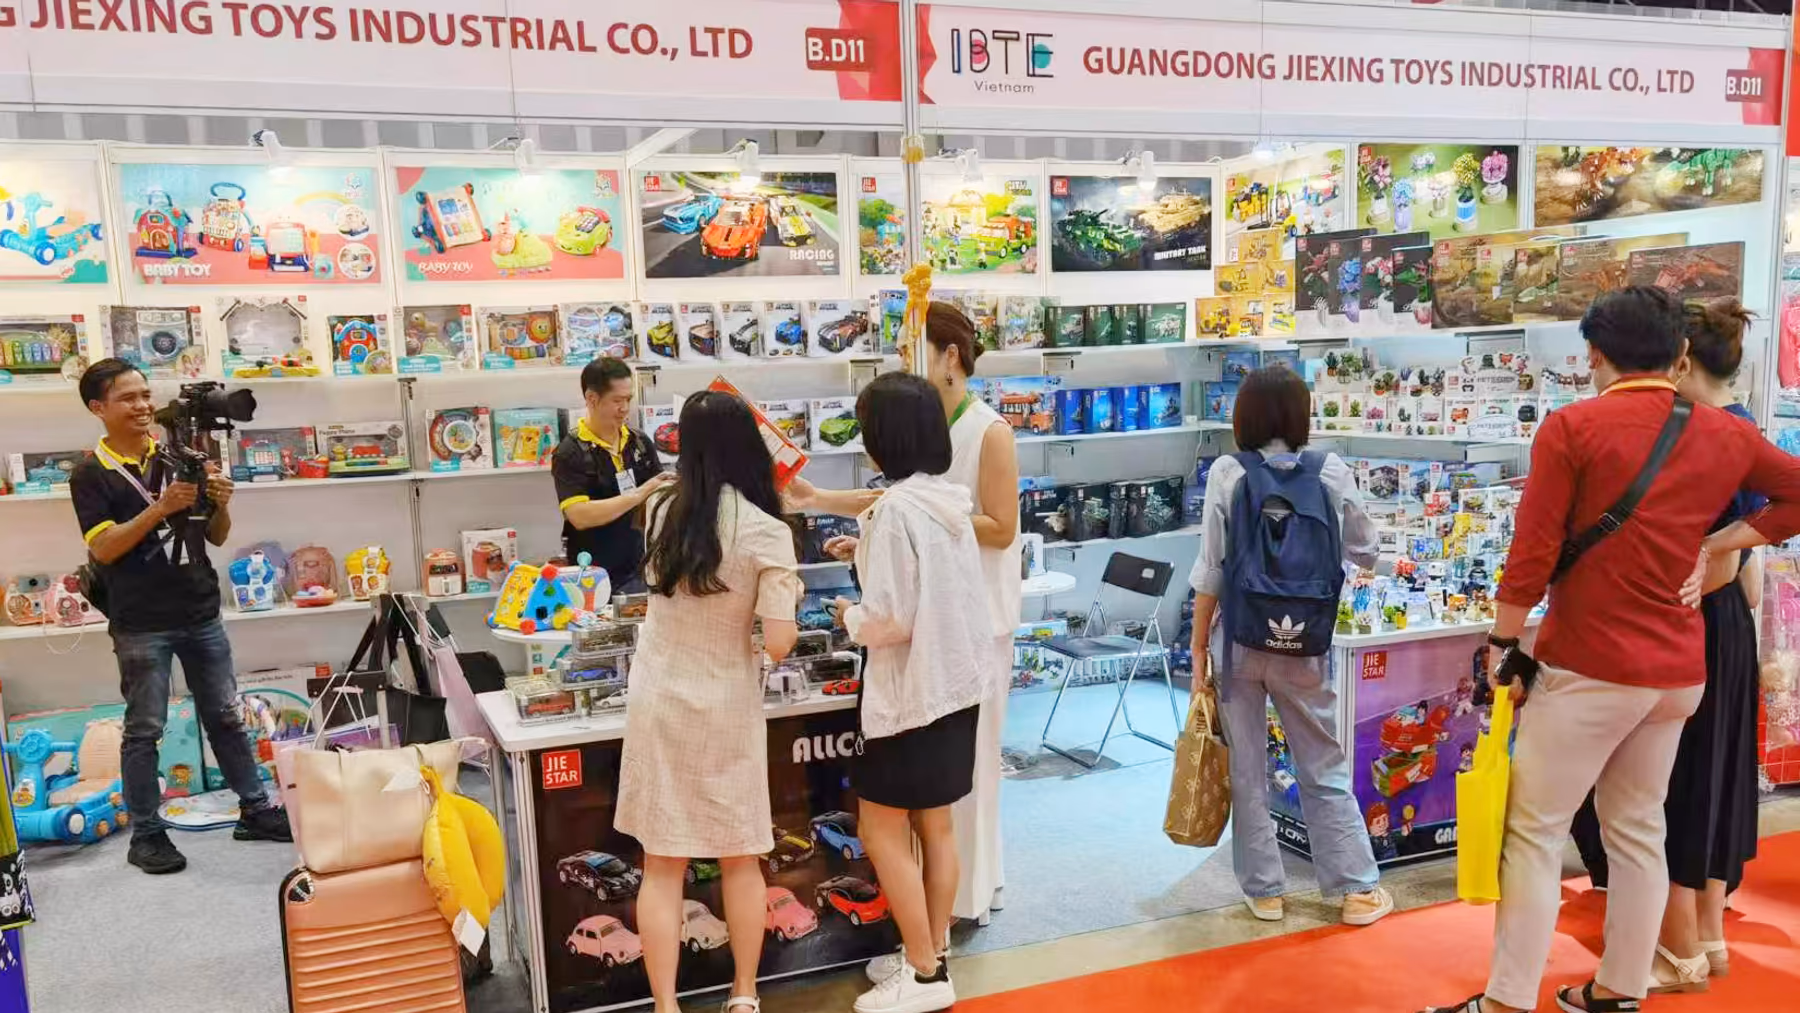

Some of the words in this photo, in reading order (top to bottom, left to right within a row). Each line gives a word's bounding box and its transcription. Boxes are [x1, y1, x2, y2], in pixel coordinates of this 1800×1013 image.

[30, 0, 213, 35] JIEXING
[222, 2, 337, 41] TOYS
[349, 8, 598, 53] INDUSTRIAL
[606, 21, 679, 61] CO.,
[688, 26, 754, 59] LTD
[807, 37, 865, 63] B.D11
[951, 28, 1054, 78] IBTE
[1082, 45, 1276, 80] GUANGDONG
[1282, 54, 1384, 83] JIEXING
[1390, 58, 1454, 86] TOYS
[1461, 61, 1602, 91] INDUSTRIAL
[1608, 67, 1651, 96] CO.,
[1656, 69, 1695, 94] LTD
[974, 79, 1035, 94] Vietnam
[1726, 76, 1762, 96] B.D11
[789, 249, 835, 260] RACING
[143, 263, 180, 277] BABY
[181, 263, 211, 276] TOY
[1265, 639, 1302, 649] adidas
[1364, 654, 1379, 667] JIE
[1363, 665, 1385, 678] STAR
[792, 731, 856, 764] ALLC
[546, 755, 568, 772] JIE
[545, 770, 578, 785] STAR
